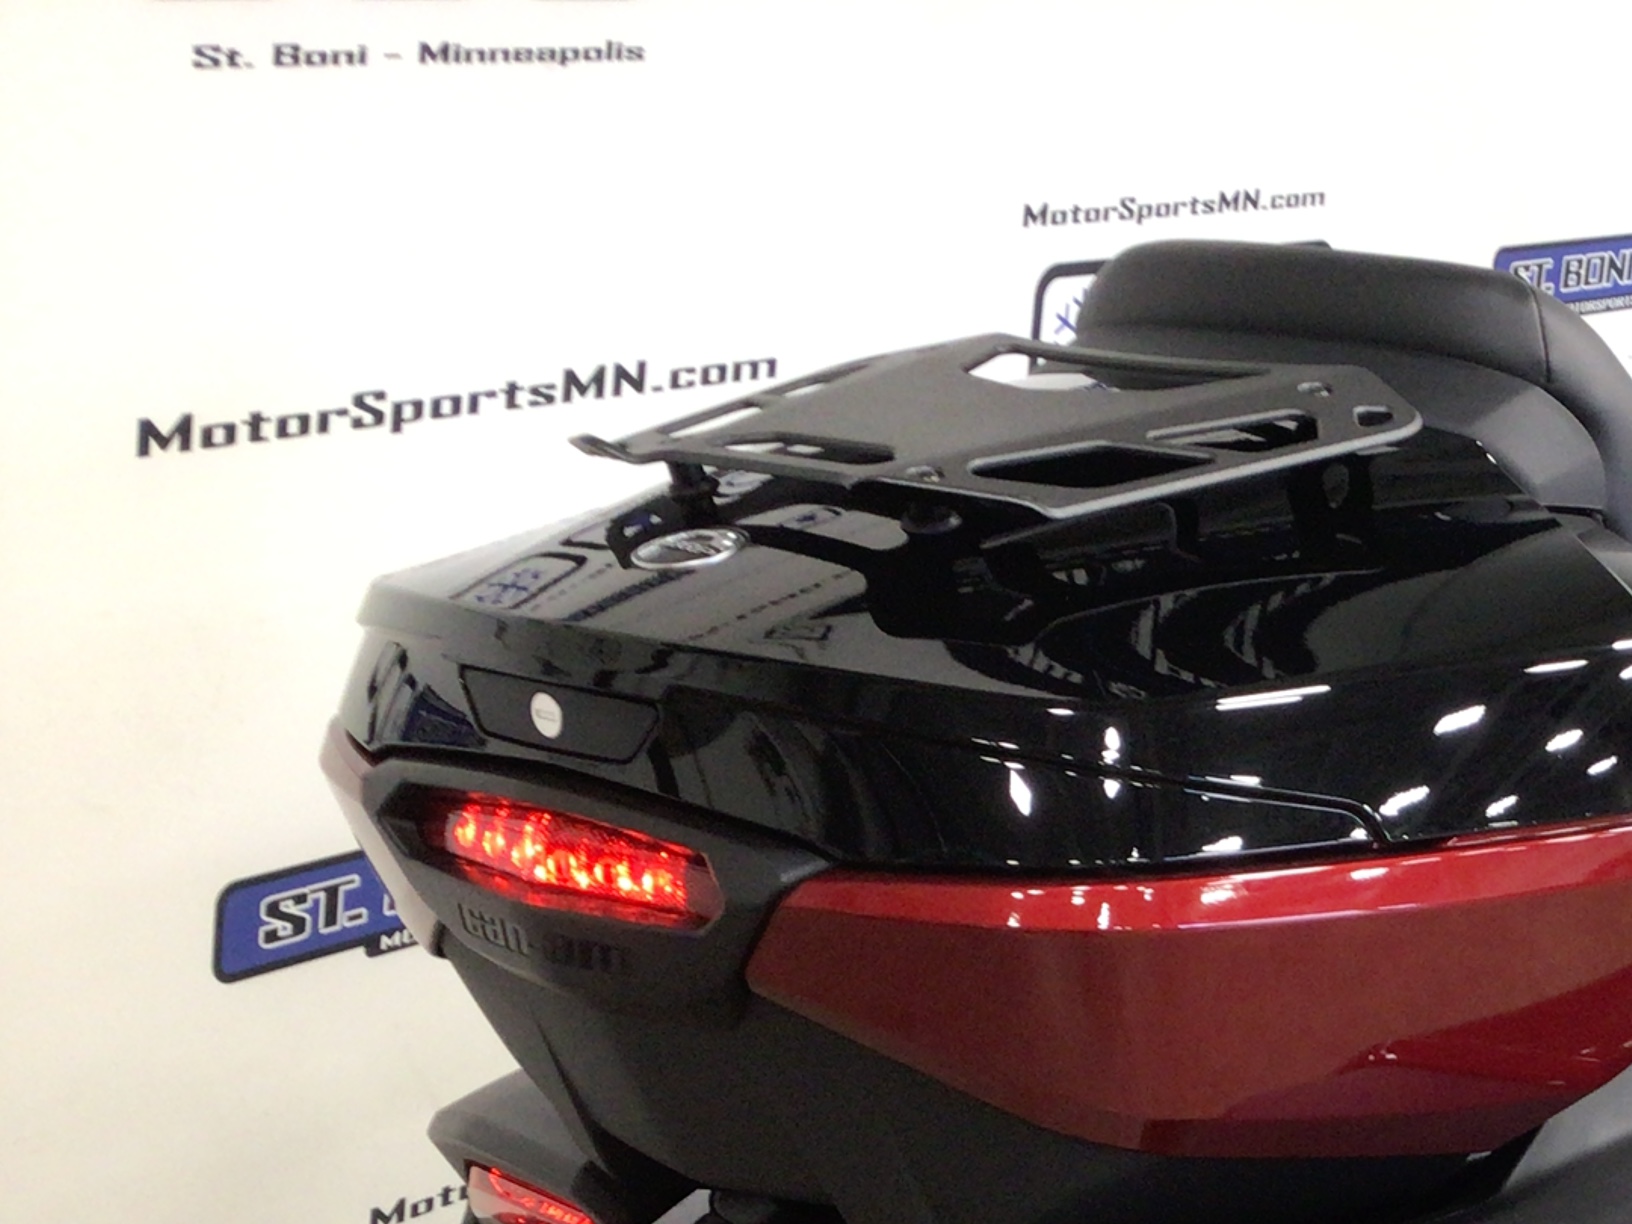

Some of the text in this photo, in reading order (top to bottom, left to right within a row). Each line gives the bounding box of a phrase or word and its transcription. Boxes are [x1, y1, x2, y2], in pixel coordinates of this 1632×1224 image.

[191, 43, 254, 70] St.
[272, 43, 368, 68] Boni
[418, 40, 646, 67] Minneapolis
[1022, 188, 1326, 228] MotorSportsMN.com
[136, 358, 778, 457] MotorSportsMN.com
[258, 873, 369, 950] ST.
